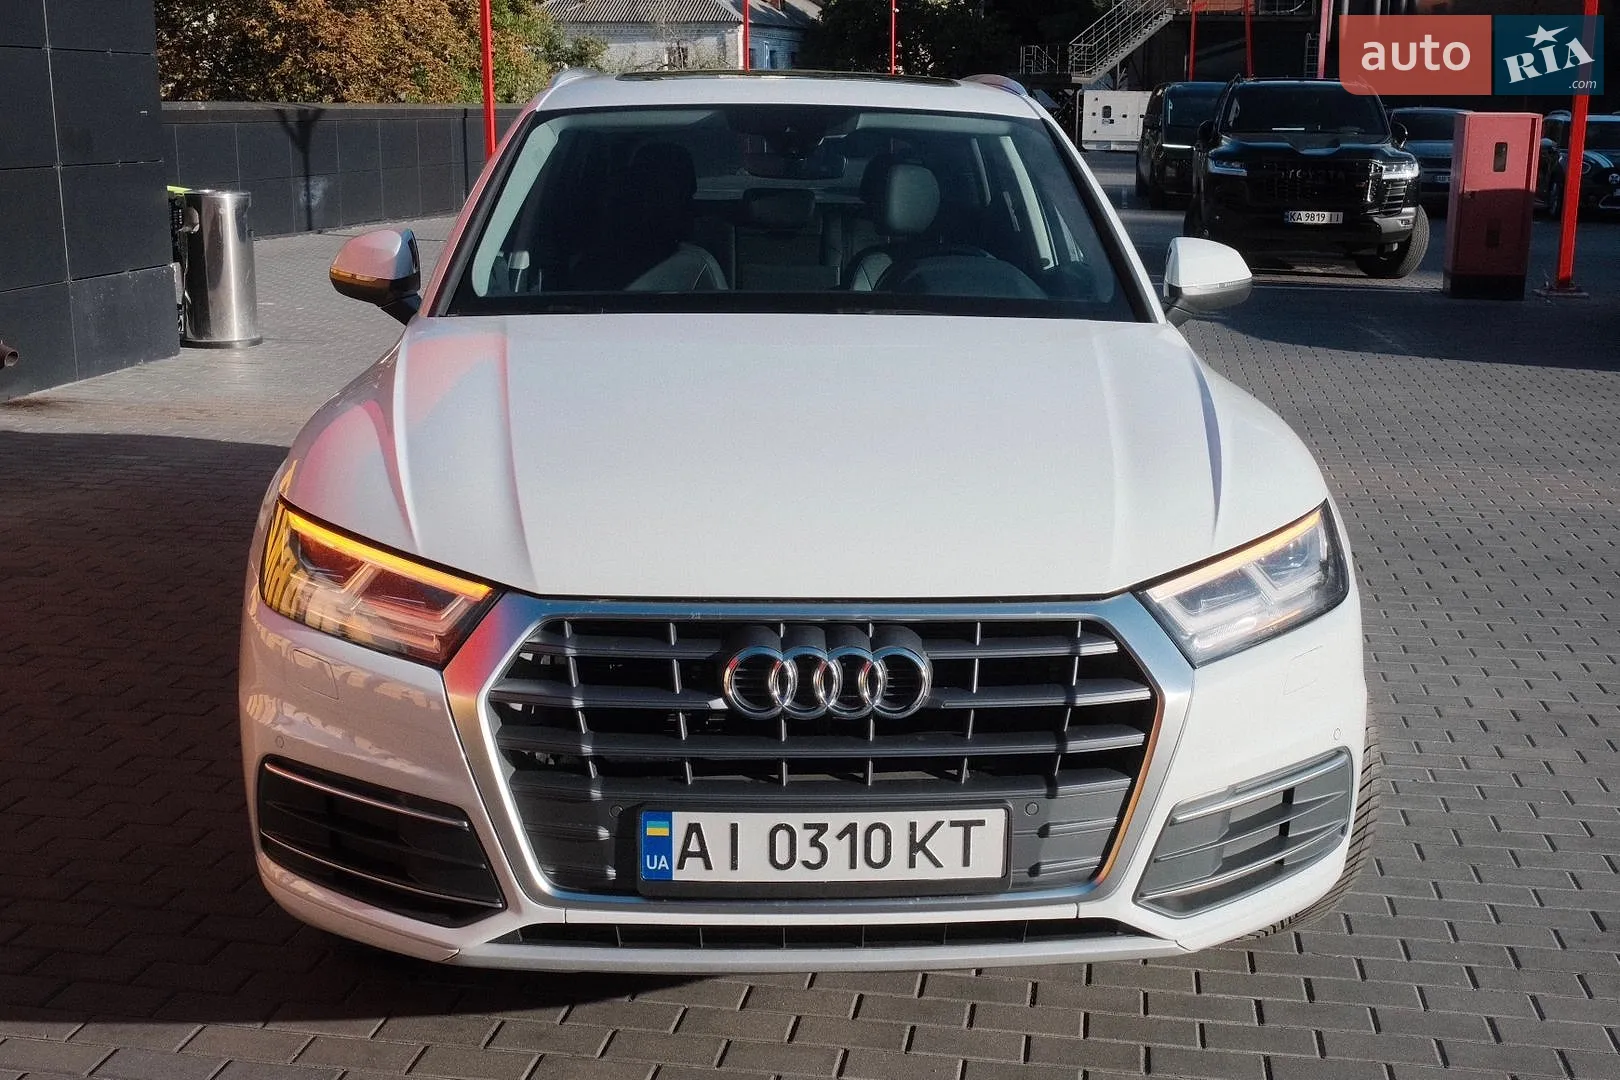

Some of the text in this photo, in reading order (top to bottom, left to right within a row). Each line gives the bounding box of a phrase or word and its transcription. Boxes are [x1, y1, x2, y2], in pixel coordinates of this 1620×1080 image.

[1289, 212, 1303, 222] KA
[1304, 212, 1326, 222] 9819
[676, 819, 986, 871] AI 0310 KT
[646, 855, 670, 870] UA
